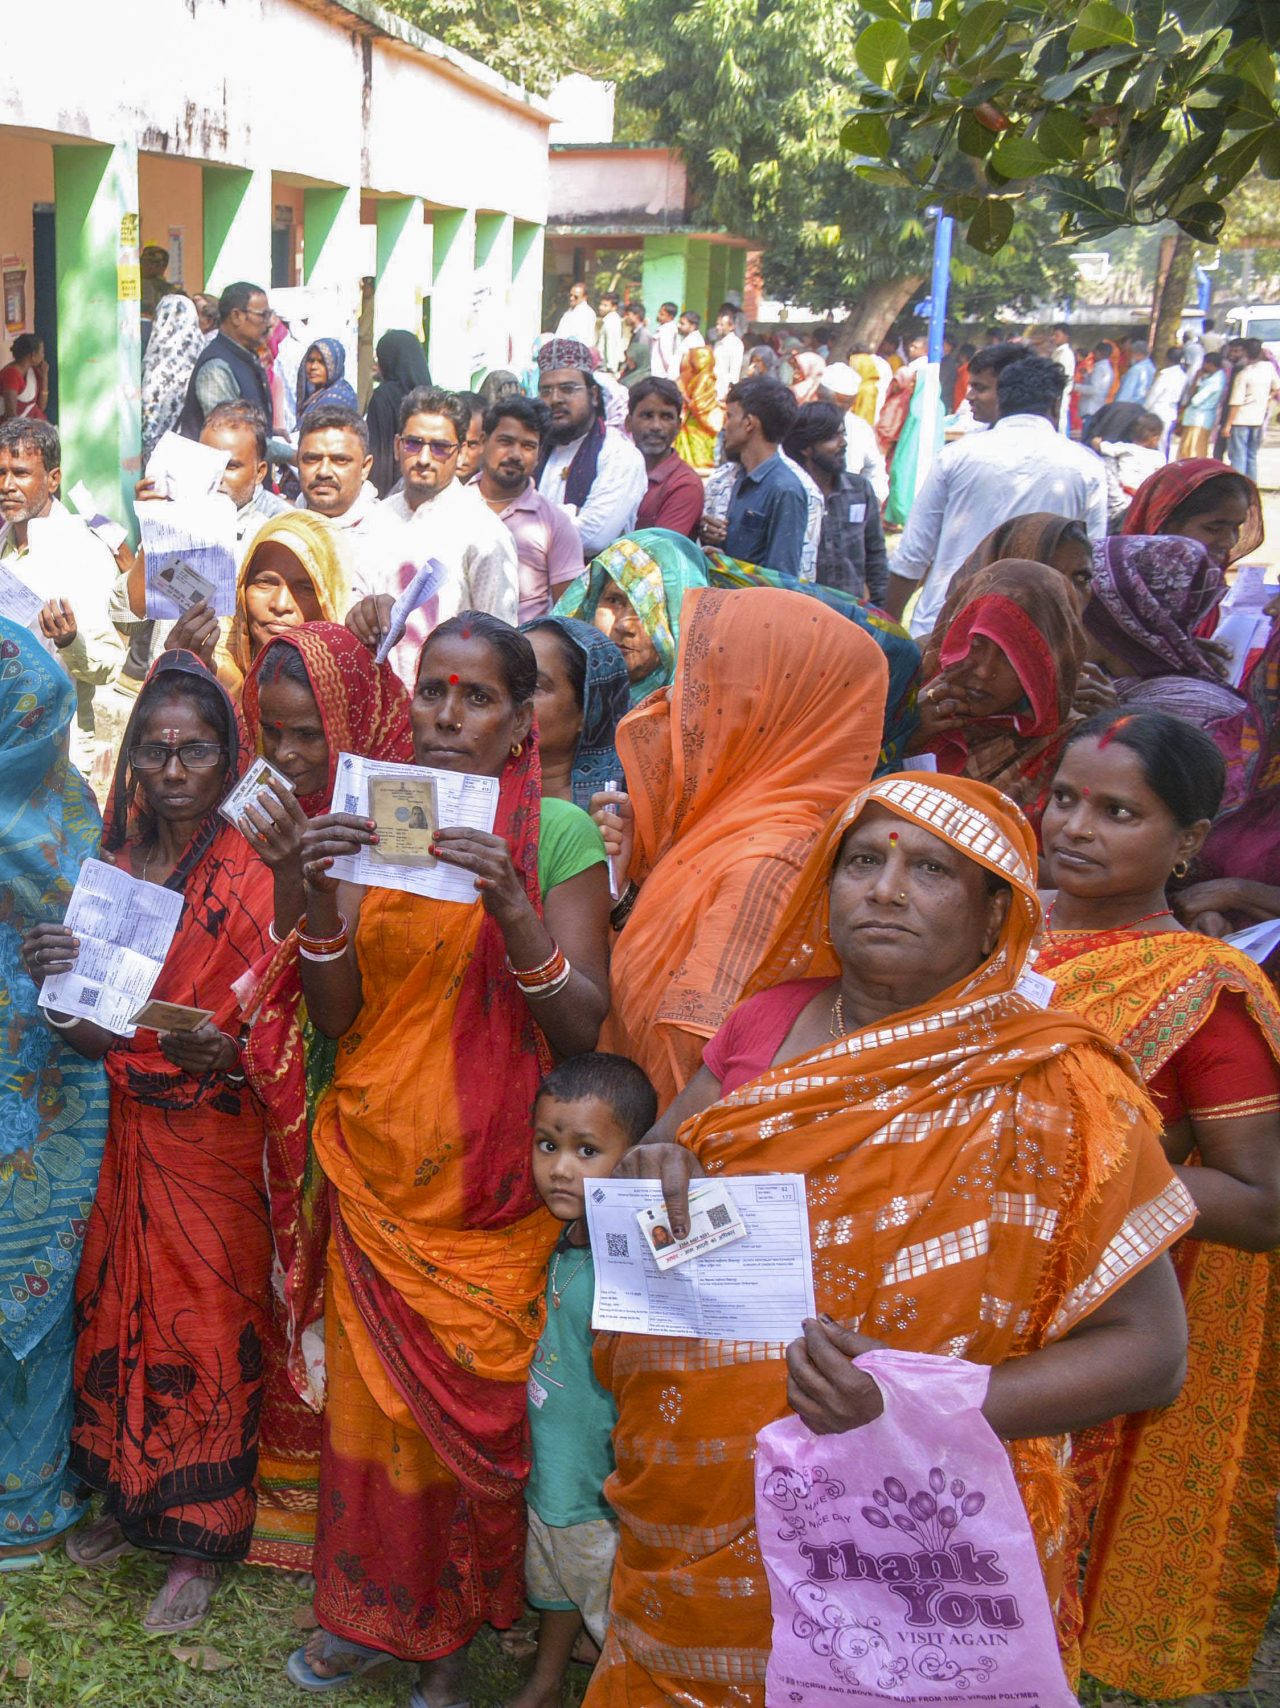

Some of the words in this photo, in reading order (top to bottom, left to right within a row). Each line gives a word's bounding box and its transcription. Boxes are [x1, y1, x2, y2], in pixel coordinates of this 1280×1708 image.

[799, 1540, 1008, 1585] Thank
[888, 1581, 1024, 1630] You
[897, 1631, 945, 1645] VISIT
[949, 1632, 1009, 1647] AGAIN
[893, 1696, 917, 1704] MADE
[944, 1695, 965, 1703] 100%
[998, 1691, 1040, 1700] POLYMER
